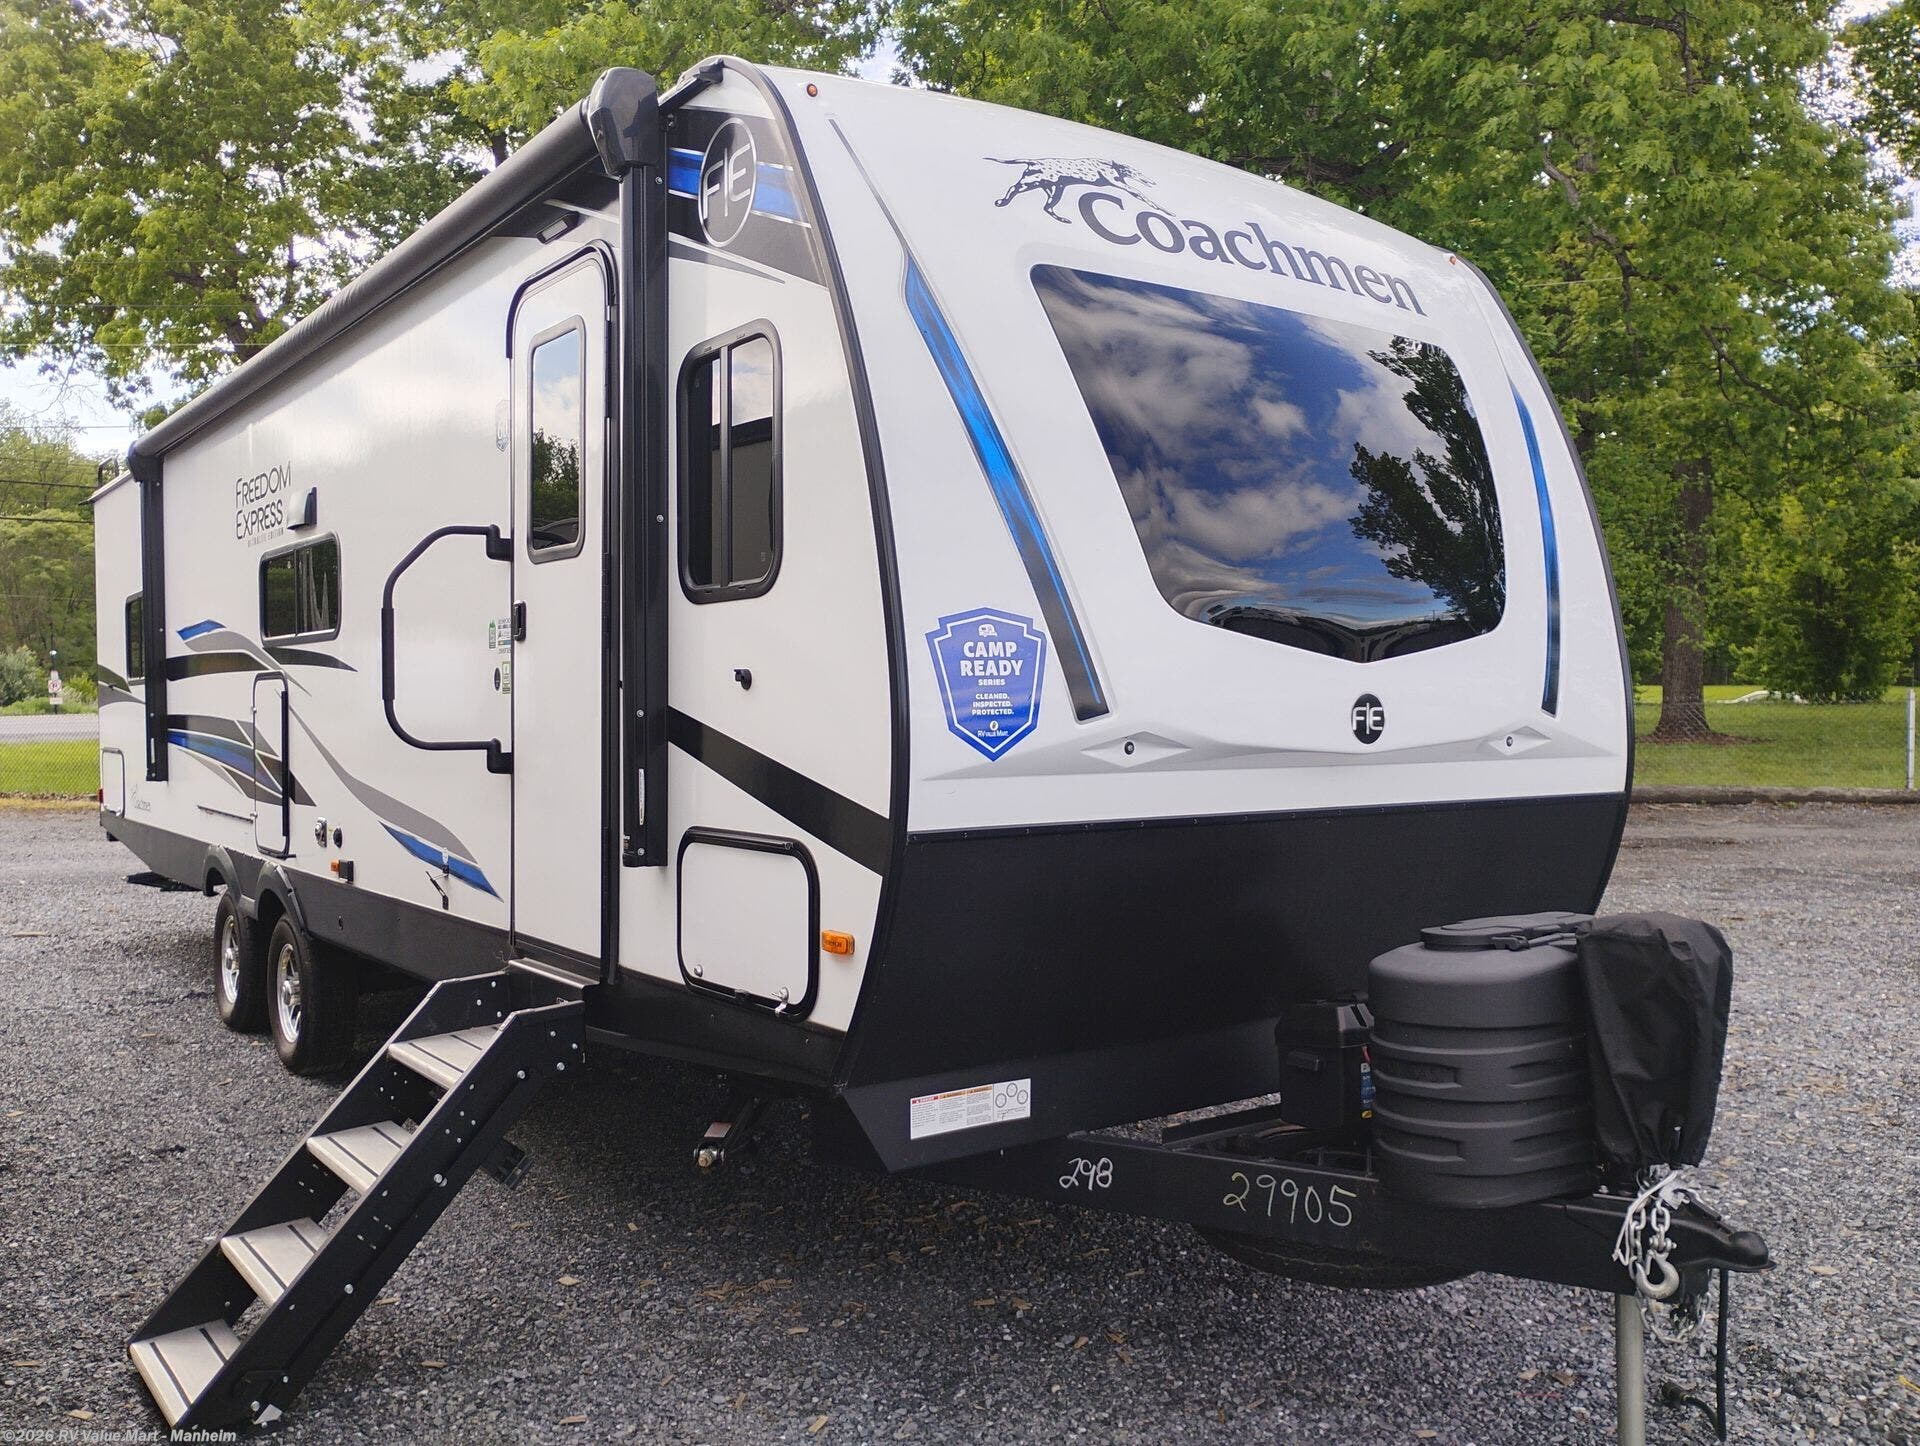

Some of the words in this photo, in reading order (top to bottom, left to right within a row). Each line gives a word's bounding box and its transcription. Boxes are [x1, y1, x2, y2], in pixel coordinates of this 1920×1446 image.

[1077, 191, 1428, 317] Coachmen
[235, 460, 291, 508] FREEDOM
[236, 499, 283, 540] EXPRESS
[960, 659, 1024, 676] READY
[963, 641, 1017, 658] CAMP
[978, 678, 1006, 686] SERIES
[1059, 1157, 1114, 1191] 298
[1223, 1172, 1357, 1227] 29905
